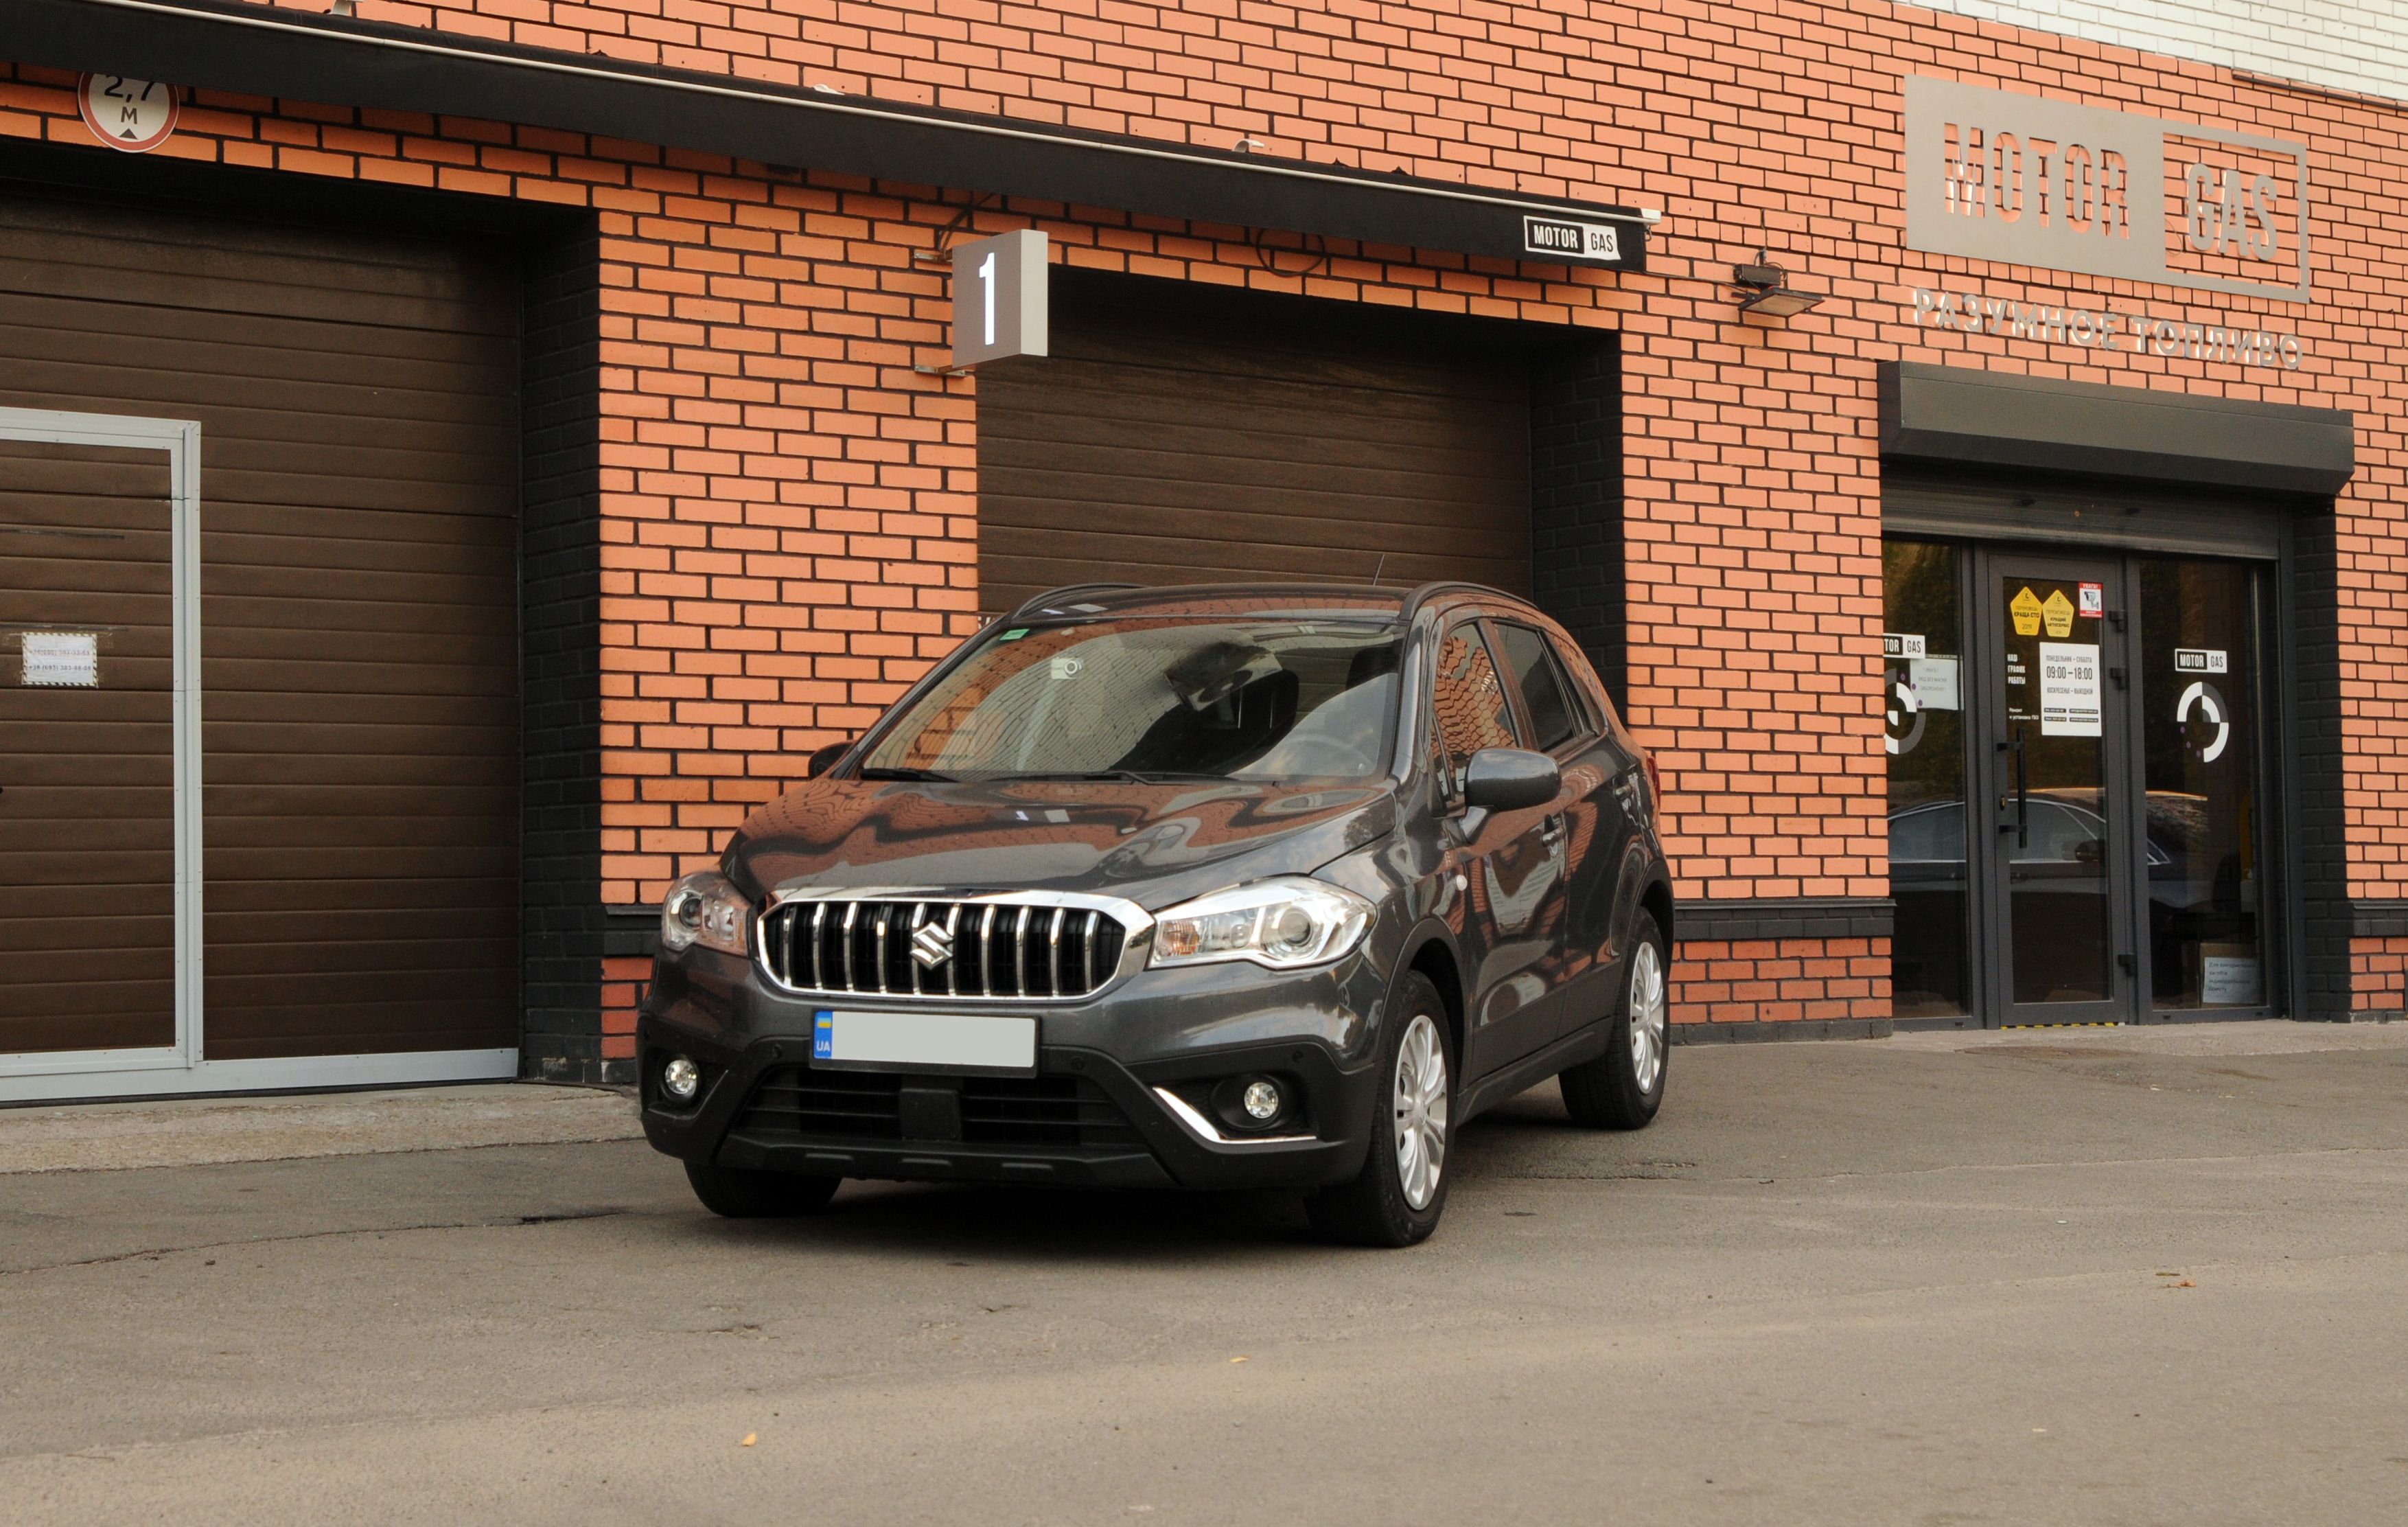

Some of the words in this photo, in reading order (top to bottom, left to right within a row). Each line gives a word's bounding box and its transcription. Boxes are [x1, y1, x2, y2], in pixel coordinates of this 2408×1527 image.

[1944, 122, 2129, 240] MOTOR
[2186, 162, 2277, 262] GAS
[1533, 225, 1579, 249] MOTOR
[1590, 232, 1614, 253] GAS
[979, 251, 995, 346] 1
[1914, 286, 2118, 350] РАЗУМНОЕ
[2131, 316, 2303, 370] ТОПЛИВО
[1884, 638, 1900, 653] TOR
[1906, 640, 1921, 654] GAS
[2179, 653, 2204, 667] MOTOR
[2210, 655, 2223, 668] GAS
[2008, 676, 2026, 685] РАБОТЫ
[2046, 666, 2066, 679] 09:00
[2074, 667, 2093, 680] 18:00
[816, 1040, 831, 1052] UA
